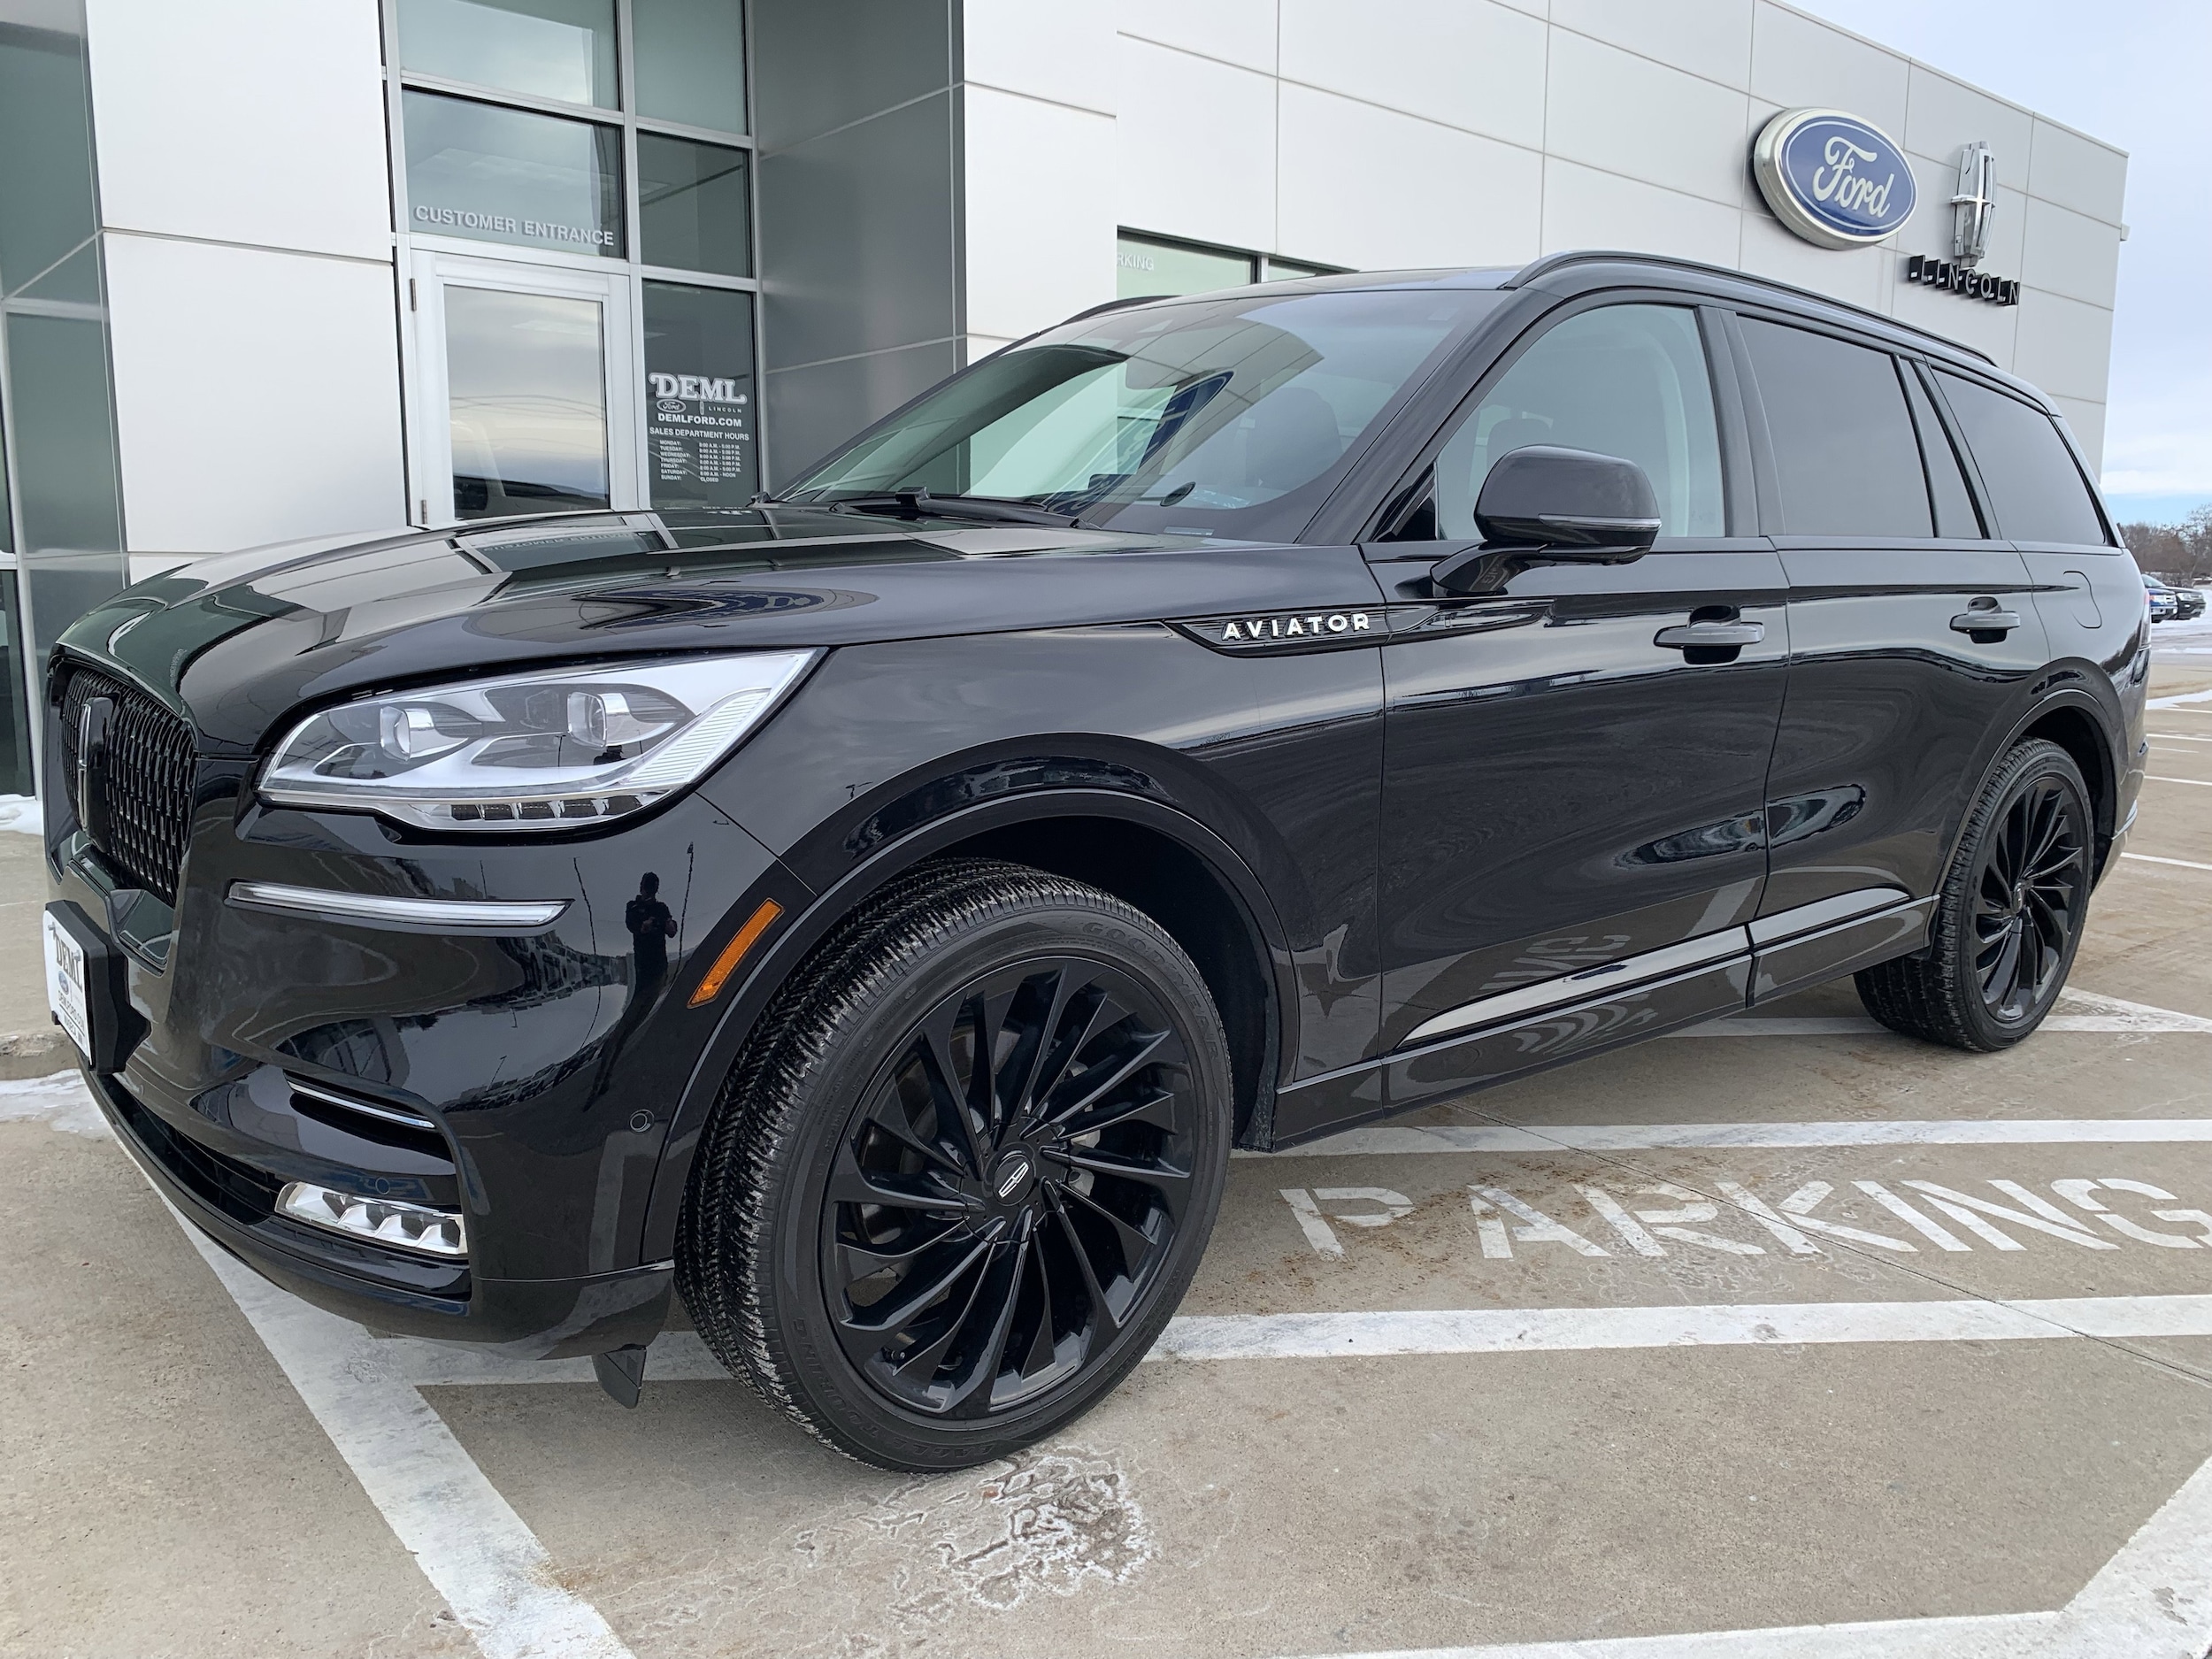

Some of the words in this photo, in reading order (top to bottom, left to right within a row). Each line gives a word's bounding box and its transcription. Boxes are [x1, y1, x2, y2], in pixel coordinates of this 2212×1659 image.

[1812, 135, 1895, 219] Ford
[415, 205, 517, 233] CUSTOMER
[523, 220, 614, 246] ENTRANCE
[1909, 255, 2020, 306] LINCOLN
[649, 373, 748, 404] DEML
[649, 426, 674, 436] SALES
[674, 428, 724, 439] DEPARTMENT
[724, 432, 749, 442] HOURS
[657, 412, 742, 427] DEMLFORD.COM
[1222, 612, 1371, 641] AVIATOR
[1082, 922, 1219, 1061] GOODYEAR
[1279, 1179, 2212, 1261] PARKING
[793, 1317, 882, 1439] TOURING
[891, 1436, 996, 1460] EAGLE
